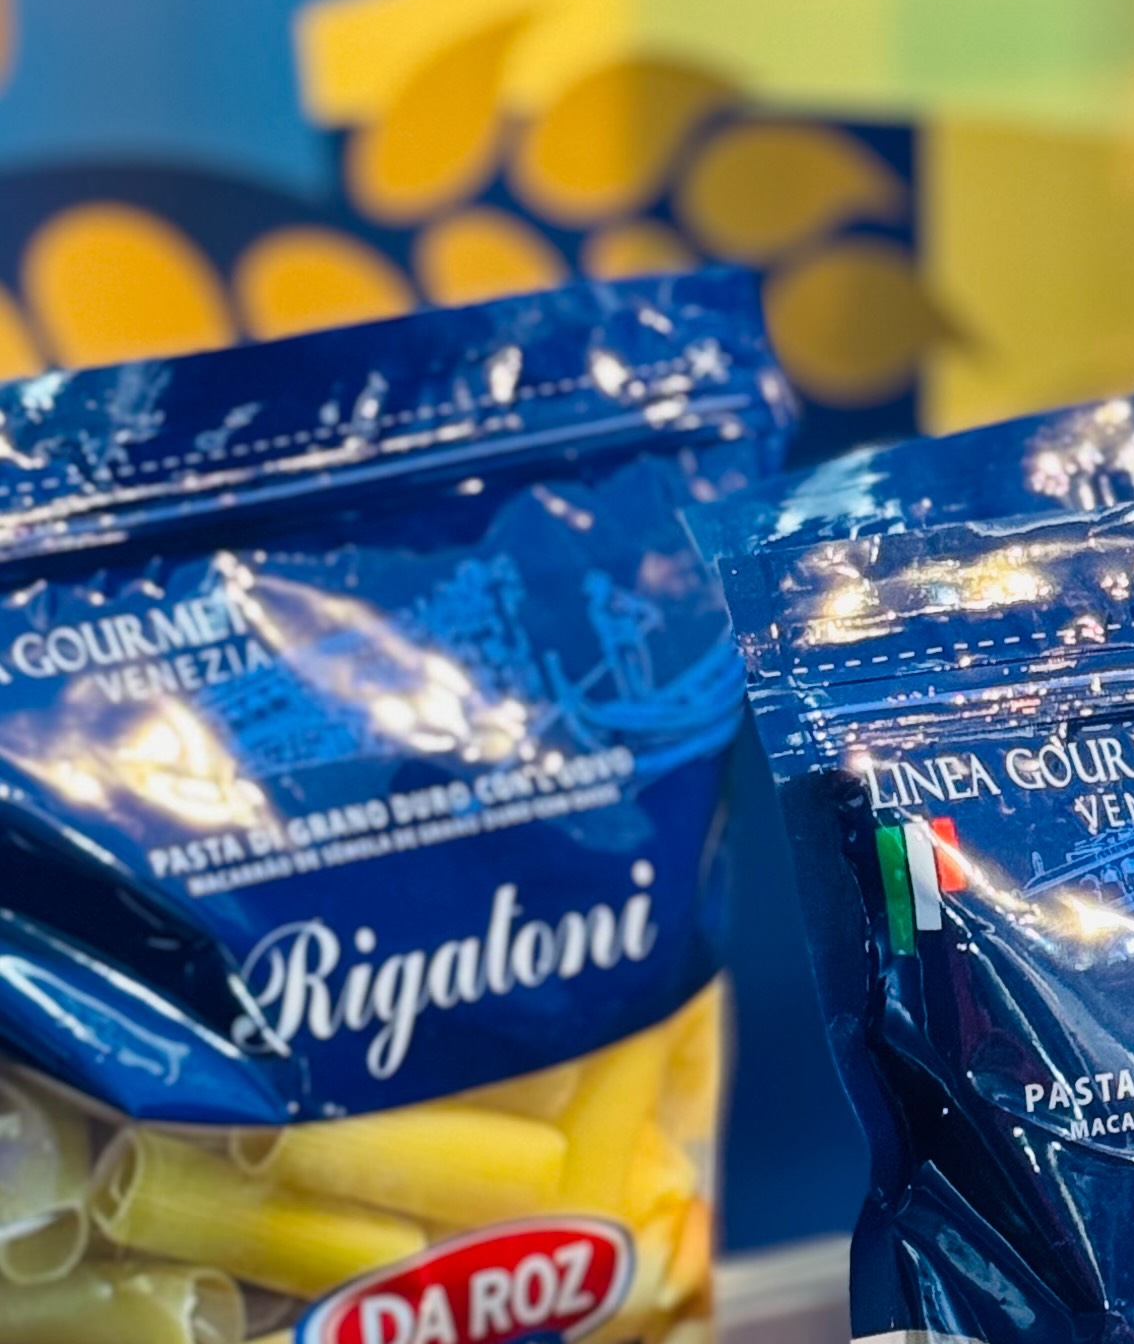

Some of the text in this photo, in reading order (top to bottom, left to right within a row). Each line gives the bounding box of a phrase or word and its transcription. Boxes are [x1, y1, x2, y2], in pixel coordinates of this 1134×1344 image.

[94, 639, 276, 704] VENEZIA
[867, 754, 1001, 810] LINEA
[149, 832, 245, 878] PASTA
[230, 859, 658, 1080] Rigatoni
[468, 1240, 595, 1340] ROZ
